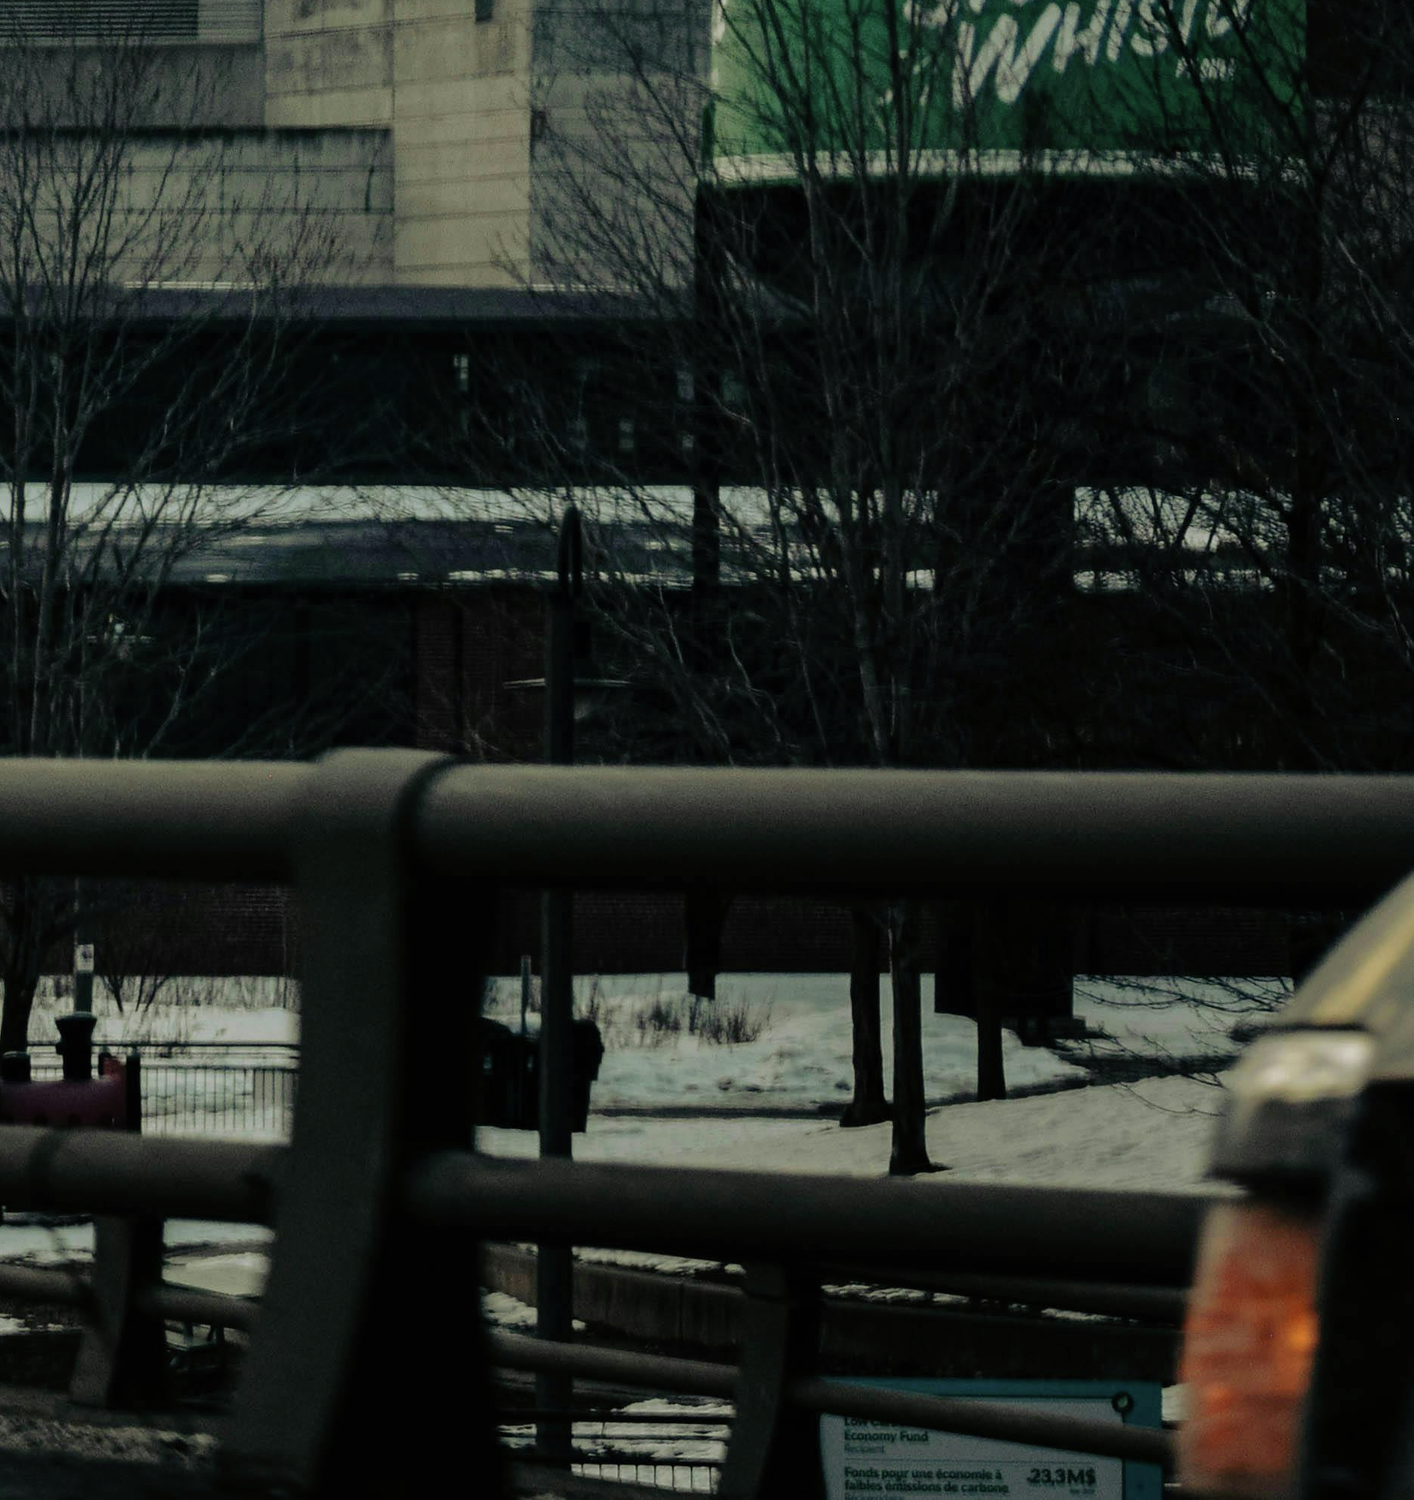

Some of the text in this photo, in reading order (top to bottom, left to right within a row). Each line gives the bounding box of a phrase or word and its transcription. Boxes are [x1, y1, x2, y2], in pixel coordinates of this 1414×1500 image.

[844, 1430, 929, 1443] Economy Fund
[844, 1466, 879, 1478] Fonds
[881, 1469, 909, 1481] pour
[911, 1470, 934, 1479] une
[936, 1468, 993, 1480] économie
[845, 1479, 1010, 1494] faibles émissions de carbone
